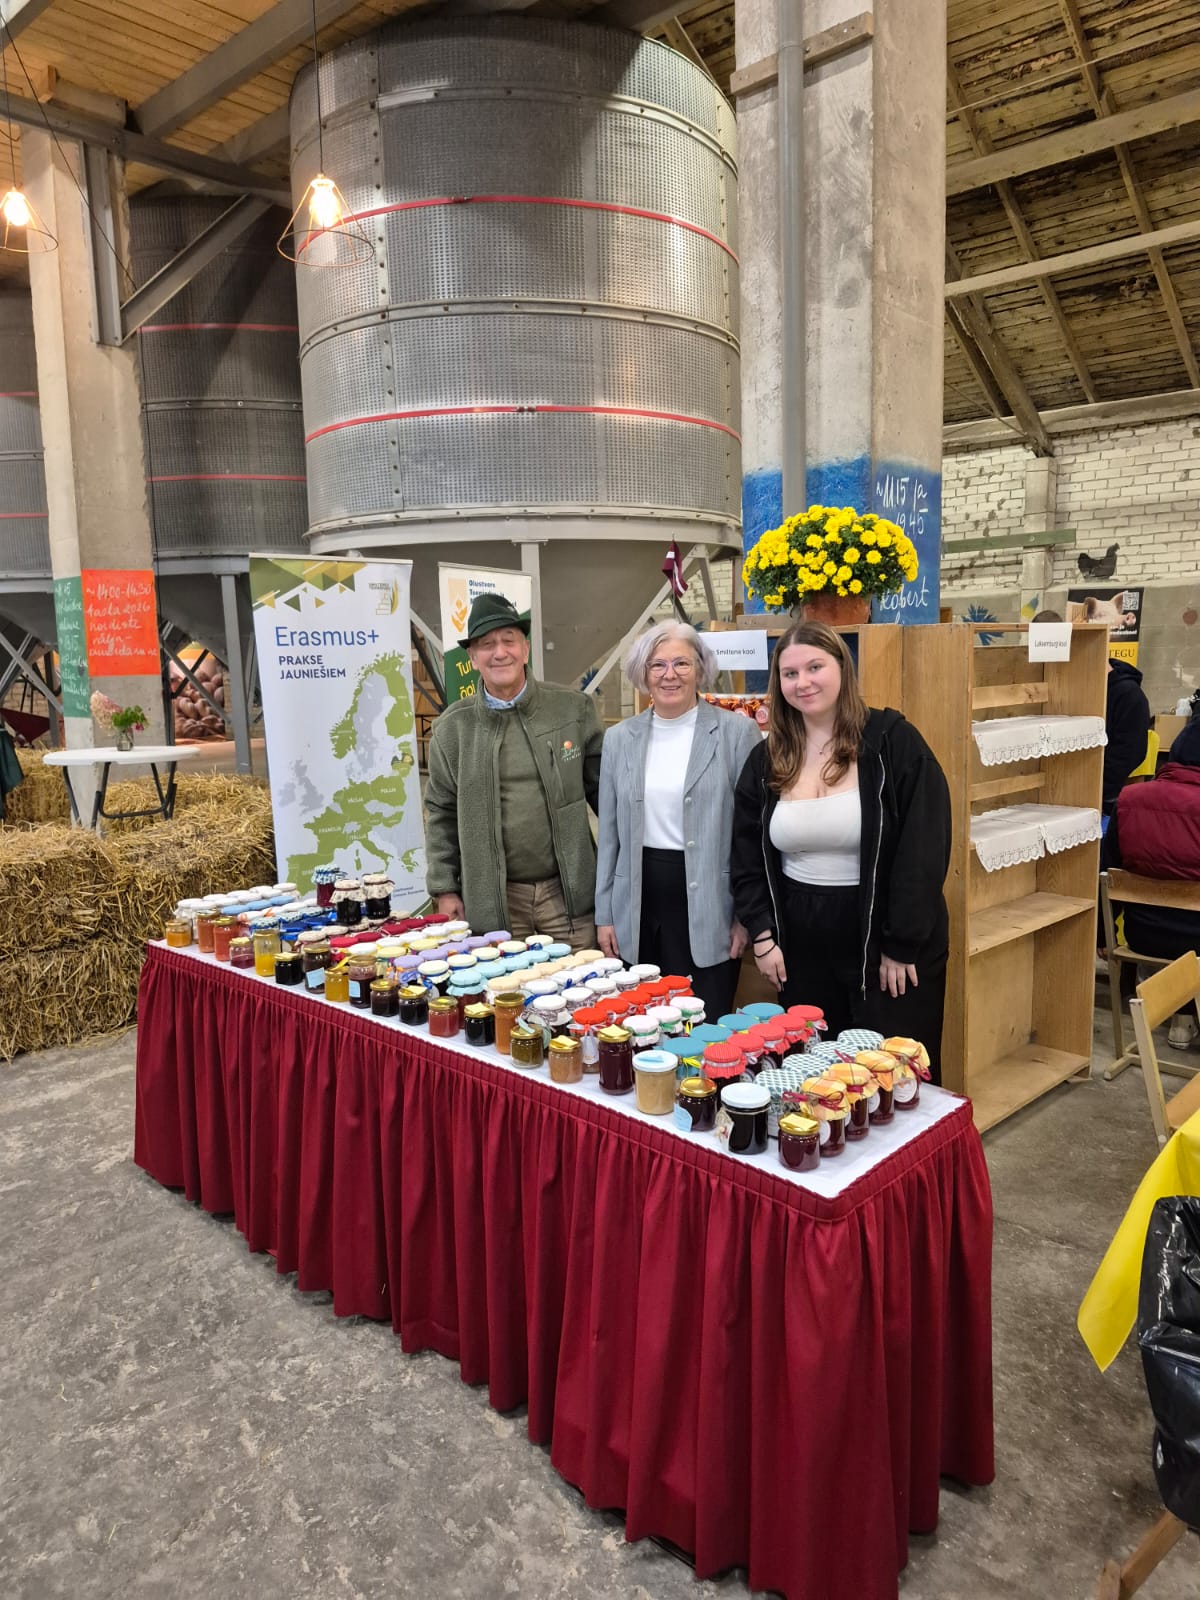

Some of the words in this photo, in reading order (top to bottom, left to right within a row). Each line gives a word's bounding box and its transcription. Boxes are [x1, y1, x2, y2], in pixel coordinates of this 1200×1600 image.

[275, 626, 379, 646] Erasmus+
[279, 655, 323, 666] PRAKSE
[280, 666, 346, 679] JAUNIEŠIEM
